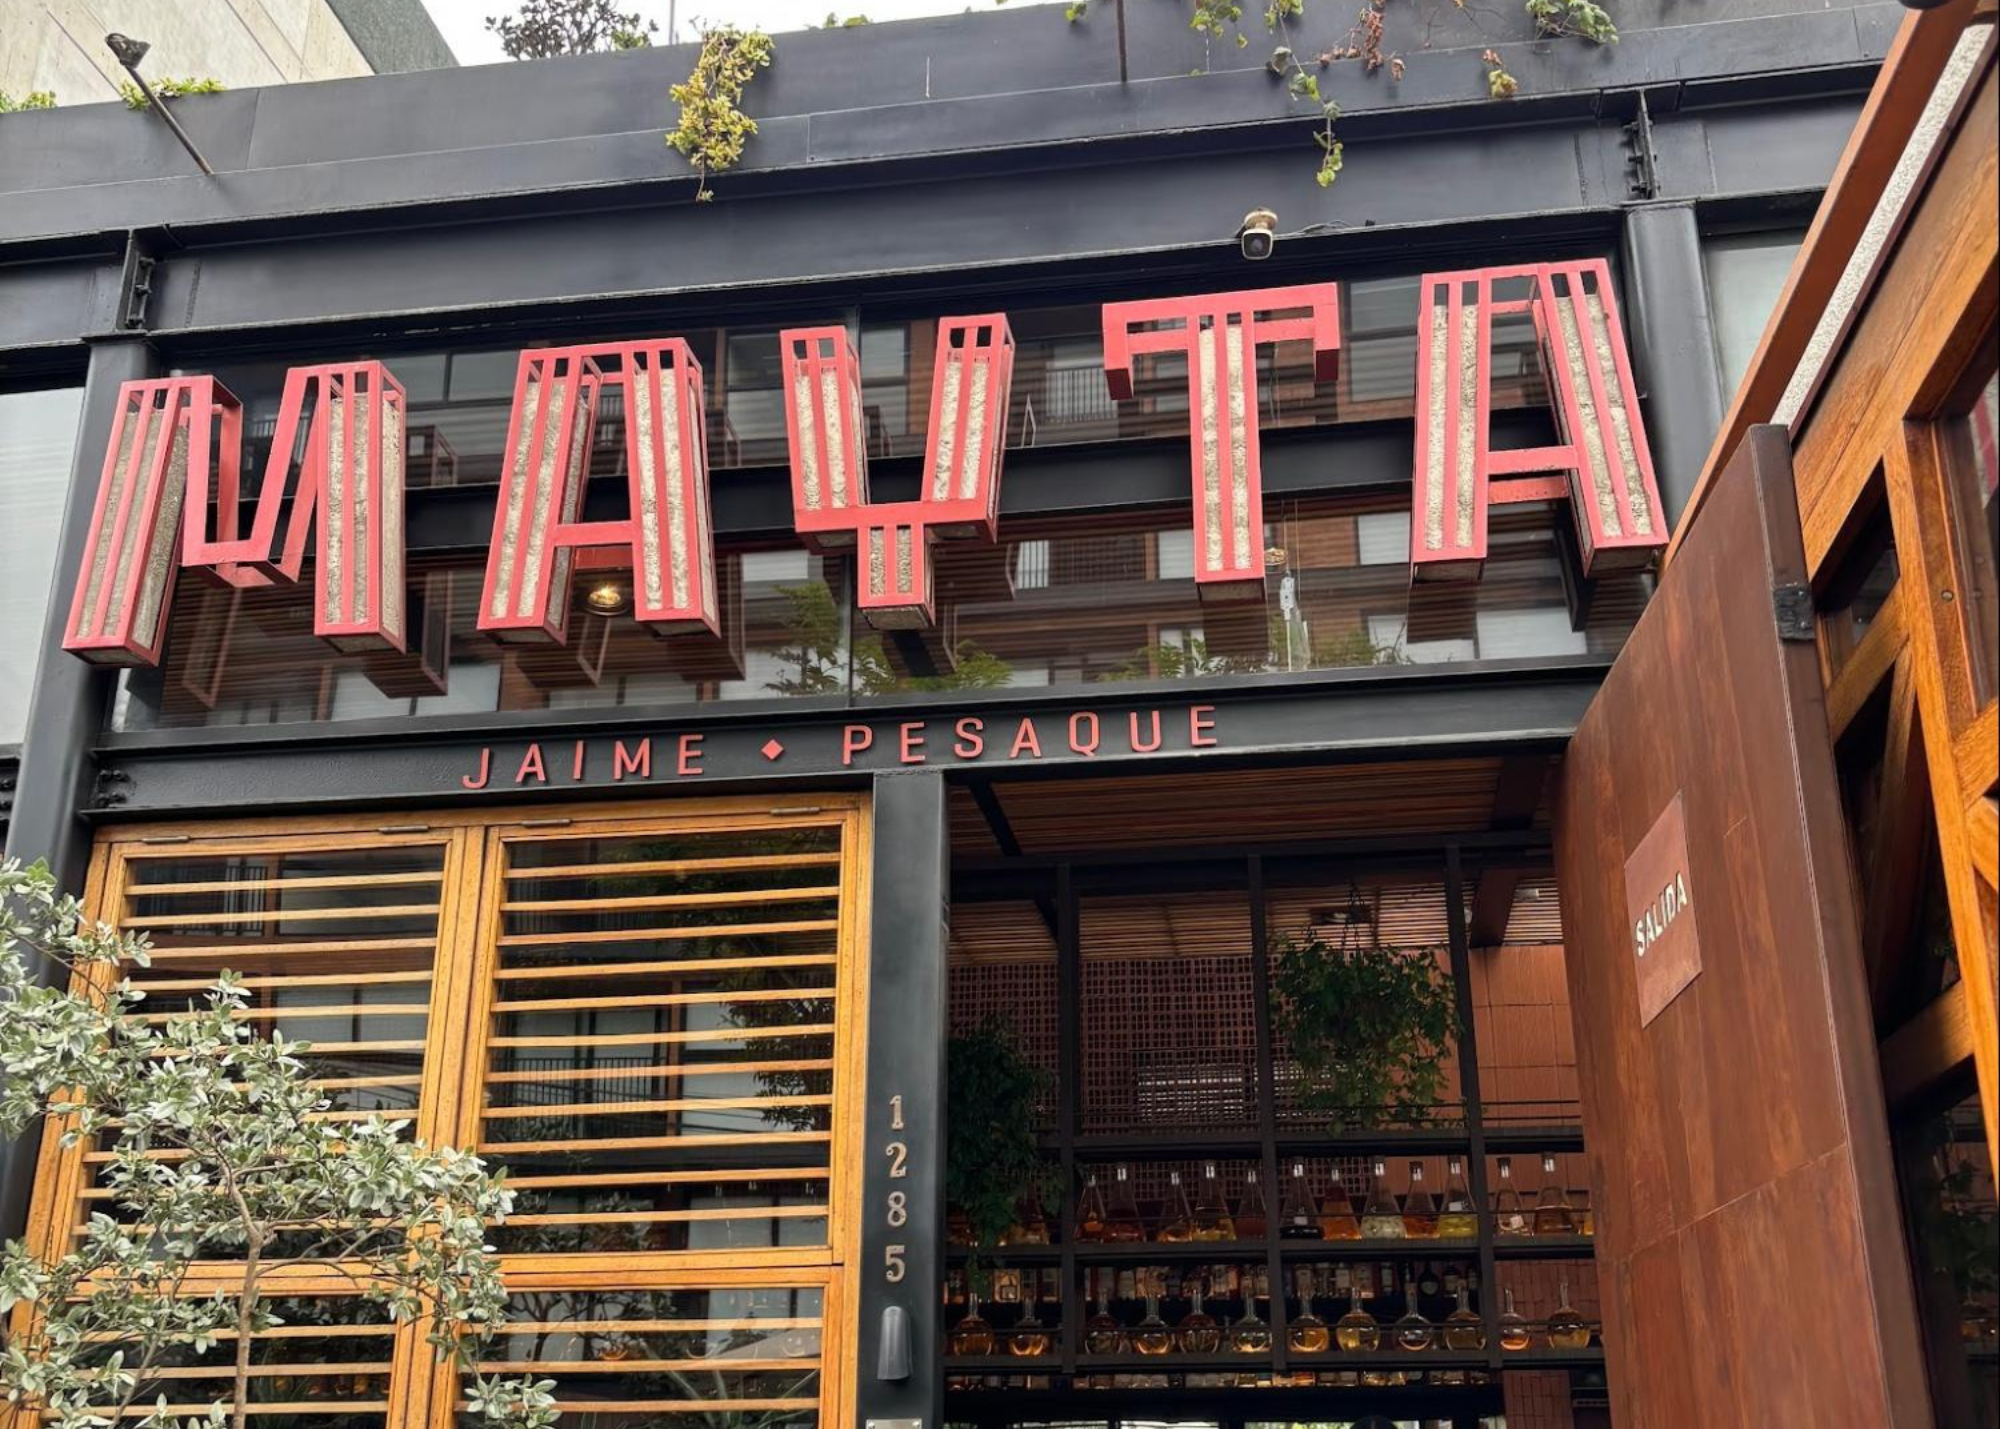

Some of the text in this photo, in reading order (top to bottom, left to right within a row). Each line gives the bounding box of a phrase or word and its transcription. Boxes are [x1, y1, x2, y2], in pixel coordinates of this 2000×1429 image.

[63, 258, 1669, 667] MAYTA
[462, 705, 1219, 789] JAIME PESAQUE
[1635, 871, 1687, 957] SALIDA
[885, 1095, 907, 1283] 1285
